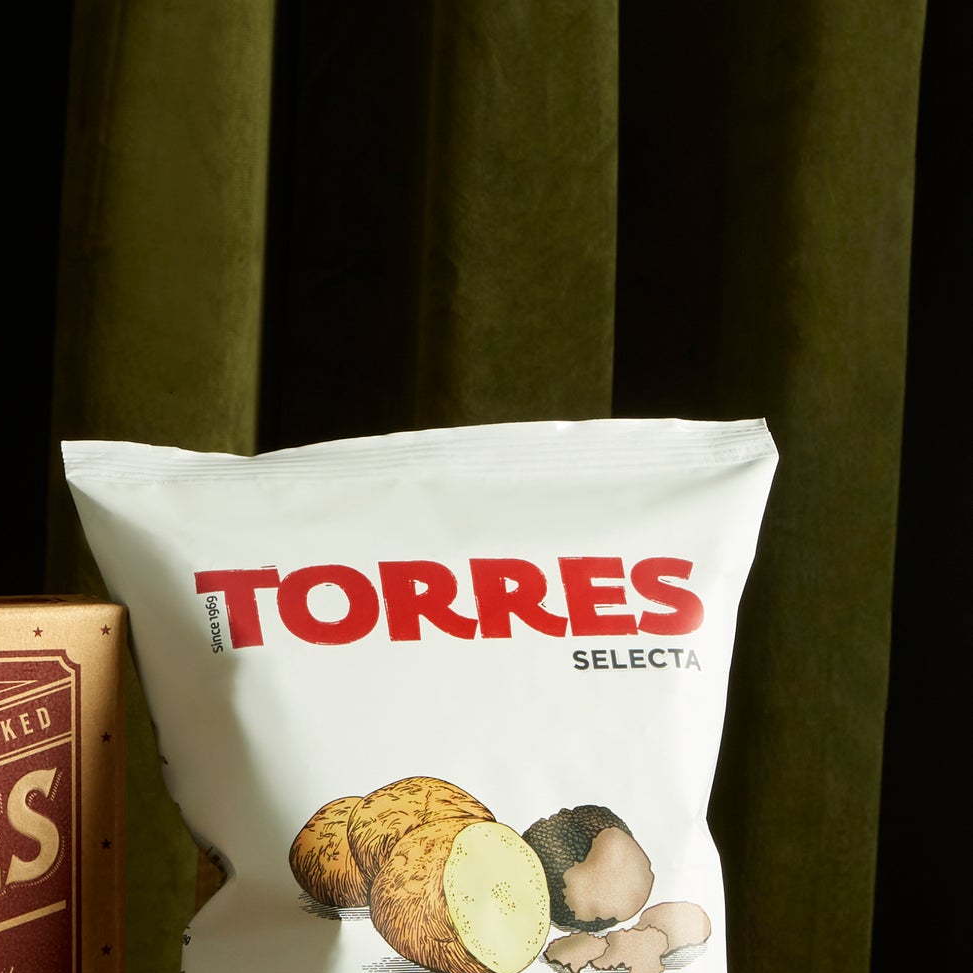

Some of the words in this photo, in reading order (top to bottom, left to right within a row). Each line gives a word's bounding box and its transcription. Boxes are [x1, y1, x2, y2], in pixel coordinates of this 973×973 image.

[193, 556, 705, 650] TORRES
[205, 596, 219, 621] 1969
[211, 622, 223, 653] Since
[573, 649, 702, 671] SELECTA
